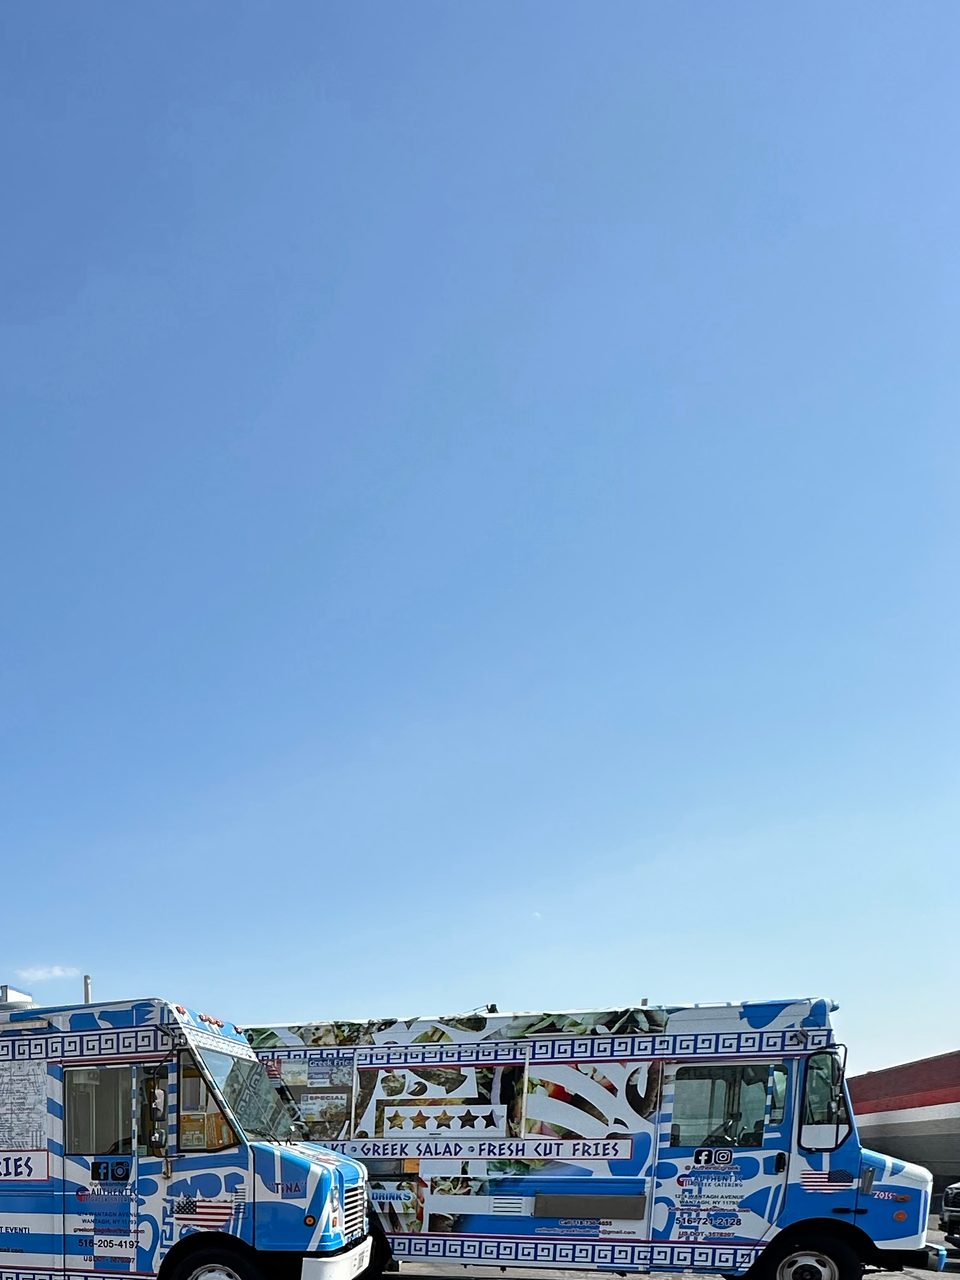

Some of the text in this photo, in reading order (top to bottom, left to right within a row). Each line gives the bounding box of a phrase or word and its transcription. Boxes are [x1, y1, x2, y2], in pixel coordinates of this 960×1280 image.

[361, 1143, 409, 1156] GREEK
[416, 1143, 463, 1156] SALAD
[479, 1143, 526, 1157] FRESH
[534, 1143, 564, 1157] CUT
[572, 1142, 620, 1157] FRIES
[371, 1192, 412, 1201] DRINKS
[675, 1217, 742, 1226] 516-721-2128
[78, 1239, 140, 1249] 516-205-4197
